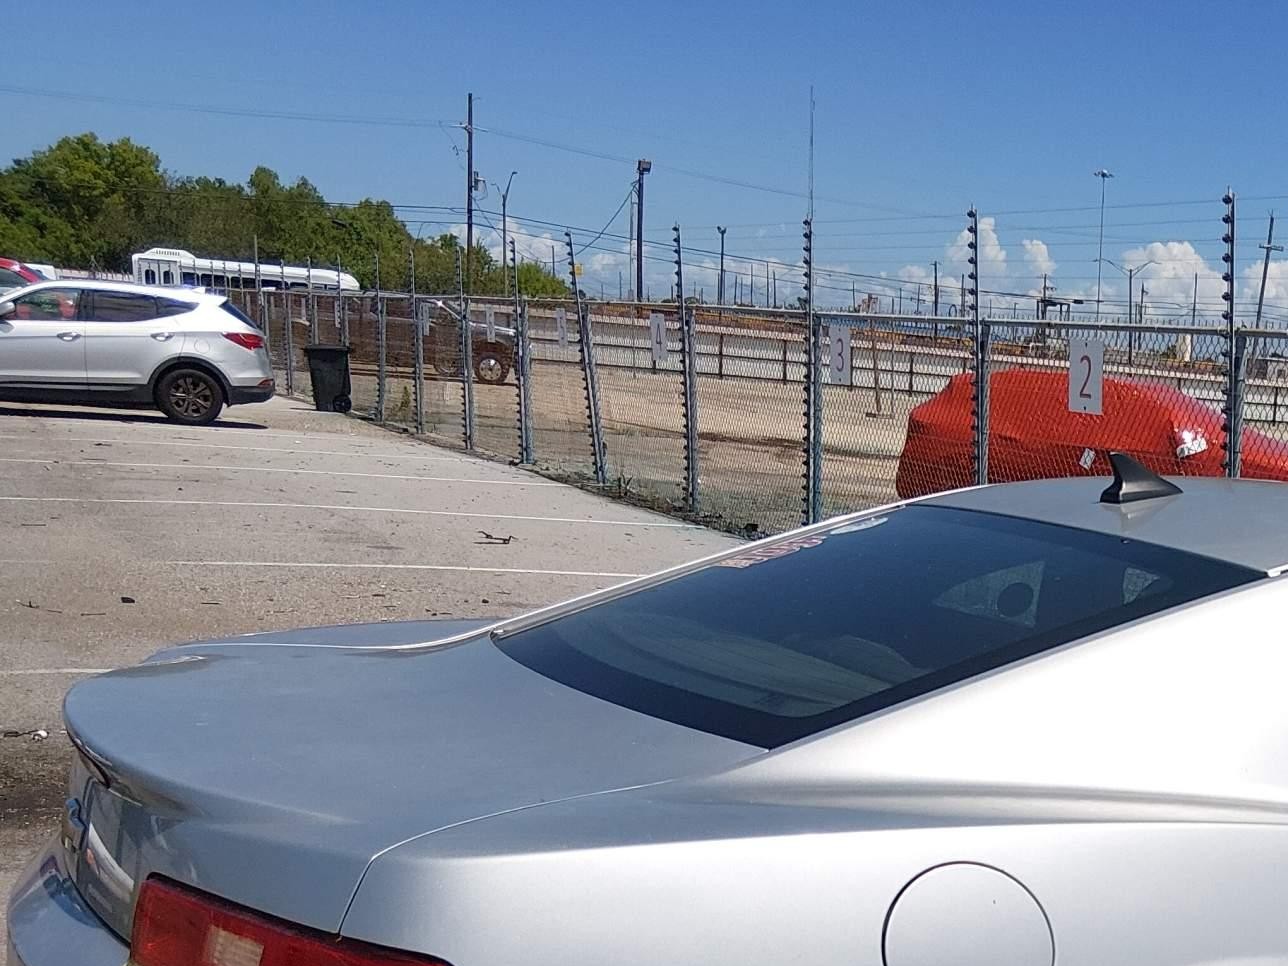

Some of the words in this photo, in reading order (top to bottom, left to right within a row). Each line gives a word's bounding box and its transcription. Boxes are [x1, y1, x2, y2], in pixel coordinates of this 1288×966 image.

[655, 322, 663, 344] 4
[836, 337, 845, 372] 3
[1079, 355, 1092, 399] 2
